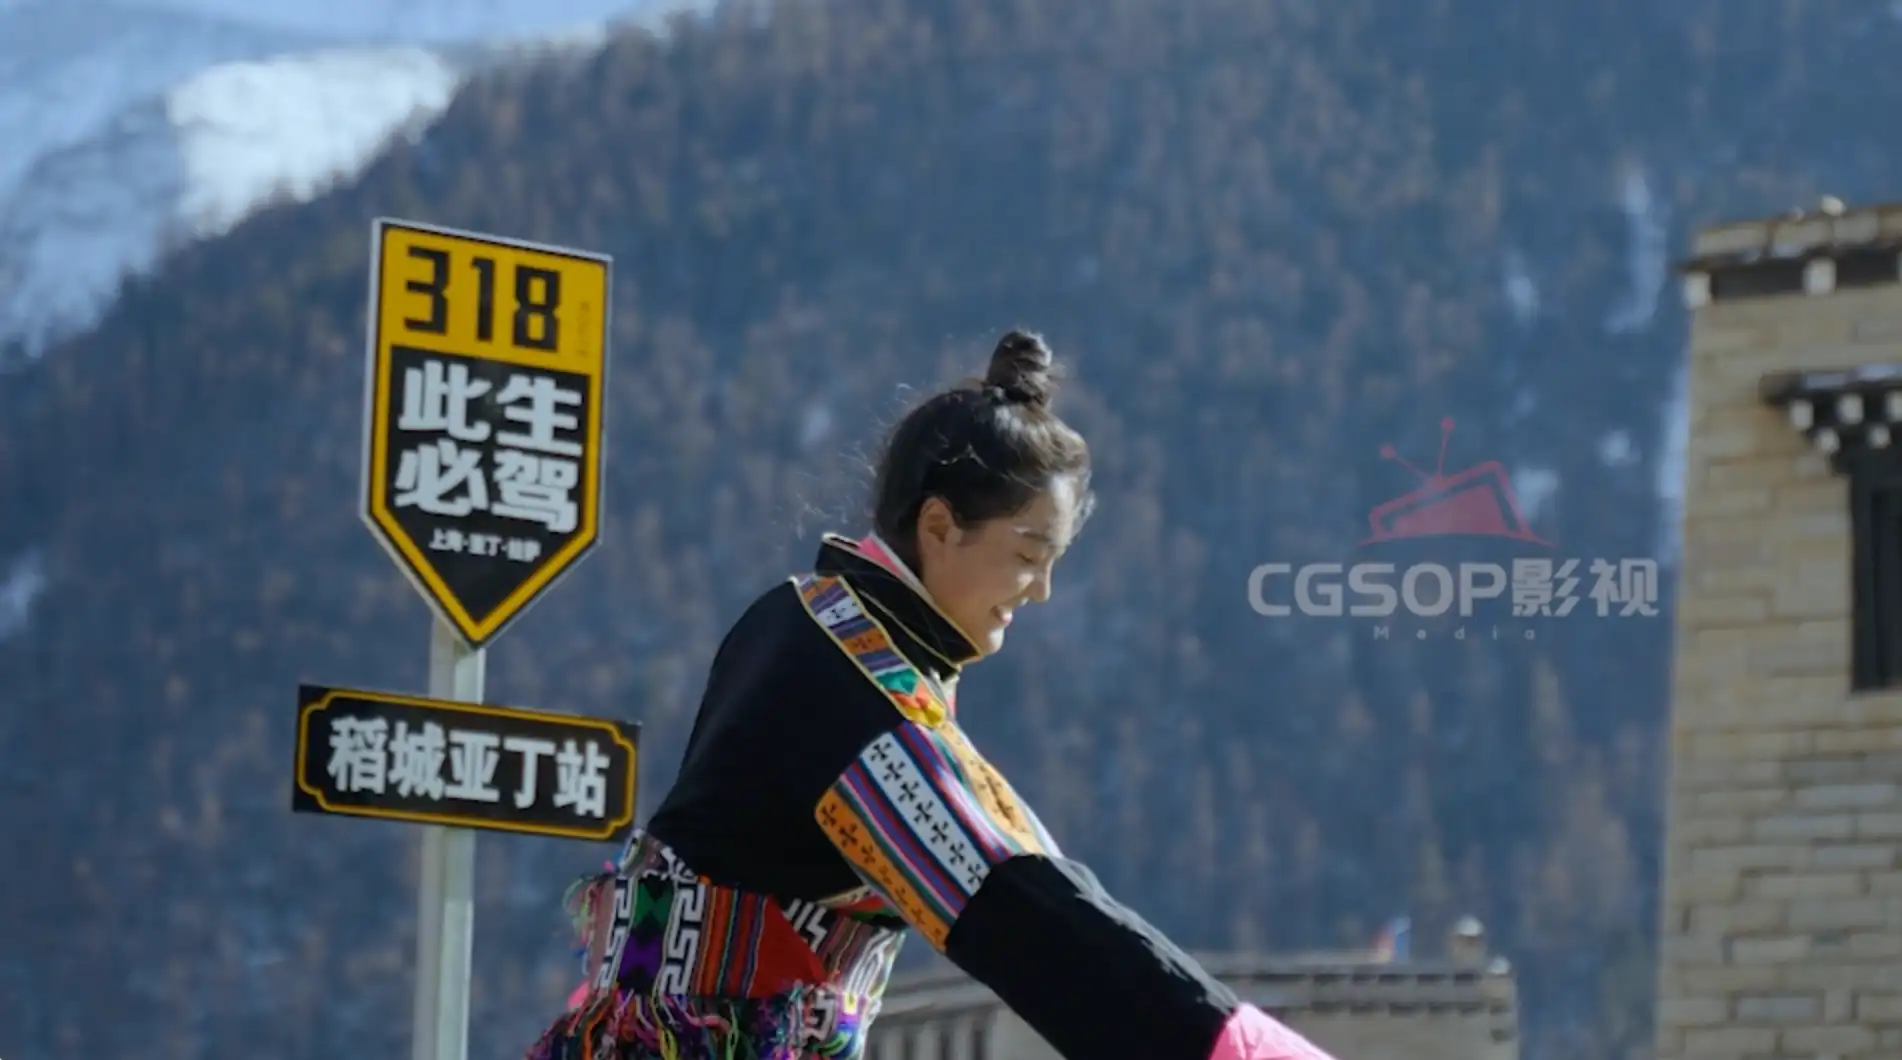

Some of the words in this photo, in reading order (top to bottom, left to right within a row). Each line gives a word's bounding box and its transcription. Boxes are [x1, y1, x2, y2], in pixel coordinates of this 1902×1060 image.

[404, 245, 561, 353] 318
[397, 360, 582, 456] 此生
[394, 438, 579, 533] 必驾
[327, 715, 610, 819] 稻城亚丁站
